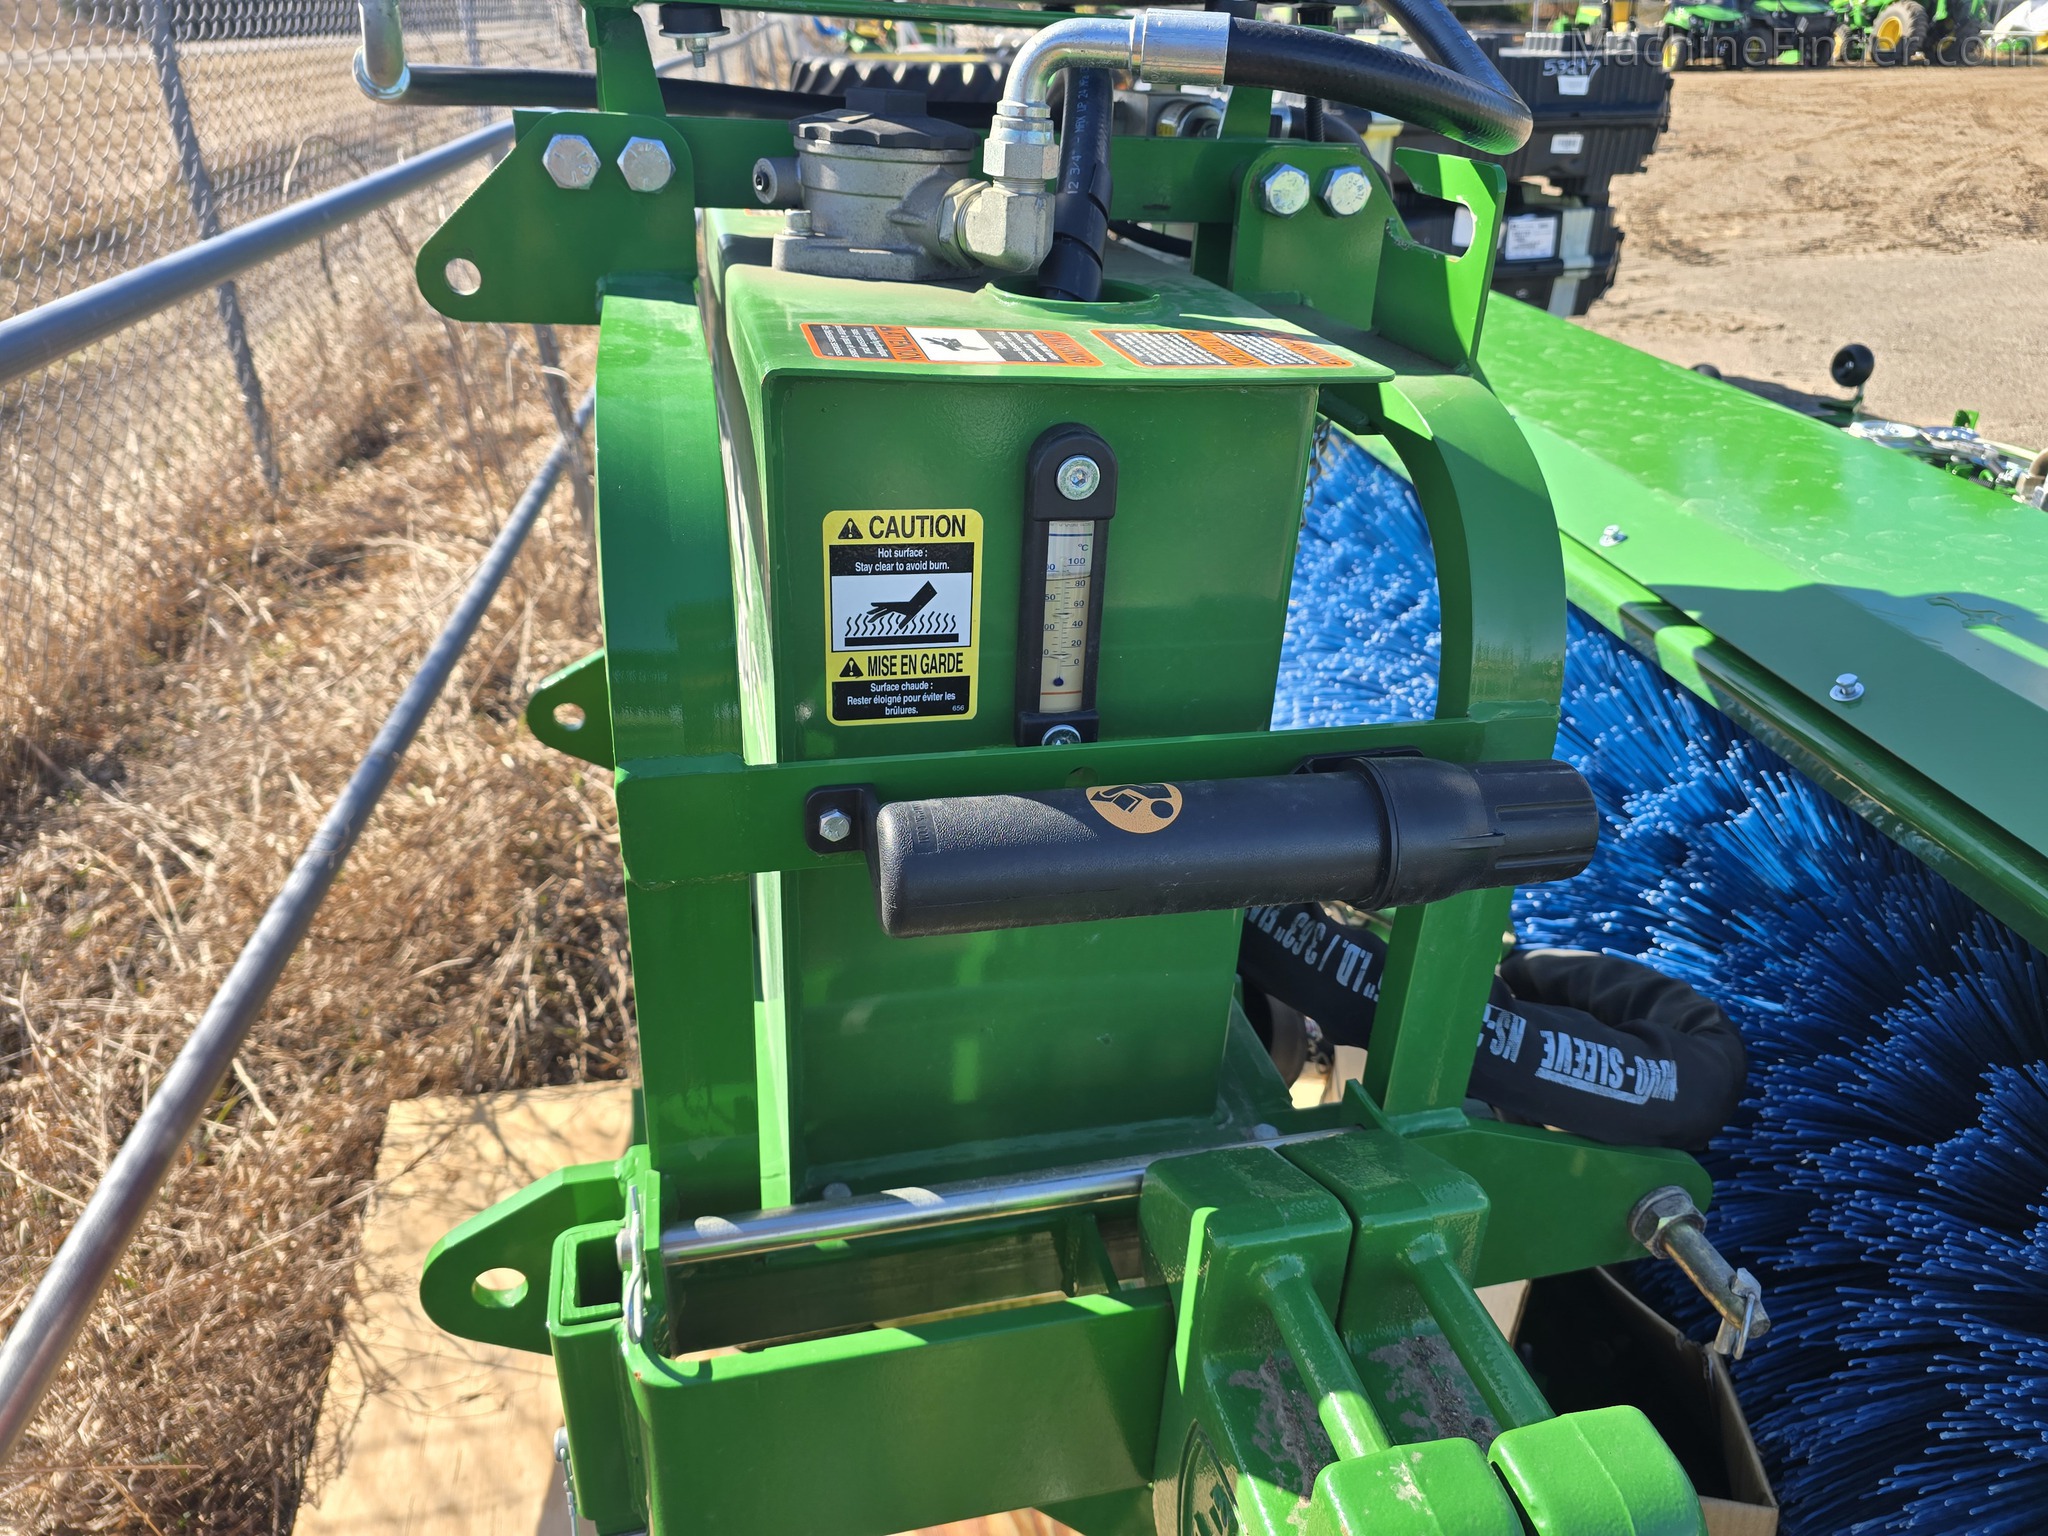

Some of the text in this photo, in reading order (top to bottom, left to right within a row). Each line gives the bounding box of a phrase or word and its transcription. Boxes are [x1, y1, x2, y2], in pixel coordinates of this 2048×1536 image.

[869, 514, 966, 540] CAUTION
[878, 548, 892, 558] Hot
[894, 547, 923, 558] surface
[855, 560, 950, 574] Stay clear to avoid burn.
[868, 652, 964, 677] MISE EN GARDE
[870, 682, 899, 693] Surface
[901, 681, 928, 691] chaude
[847, 692, 956, 707] Rester éloigné pour éviter les
[885, 704, 918, 716] brûlures.
